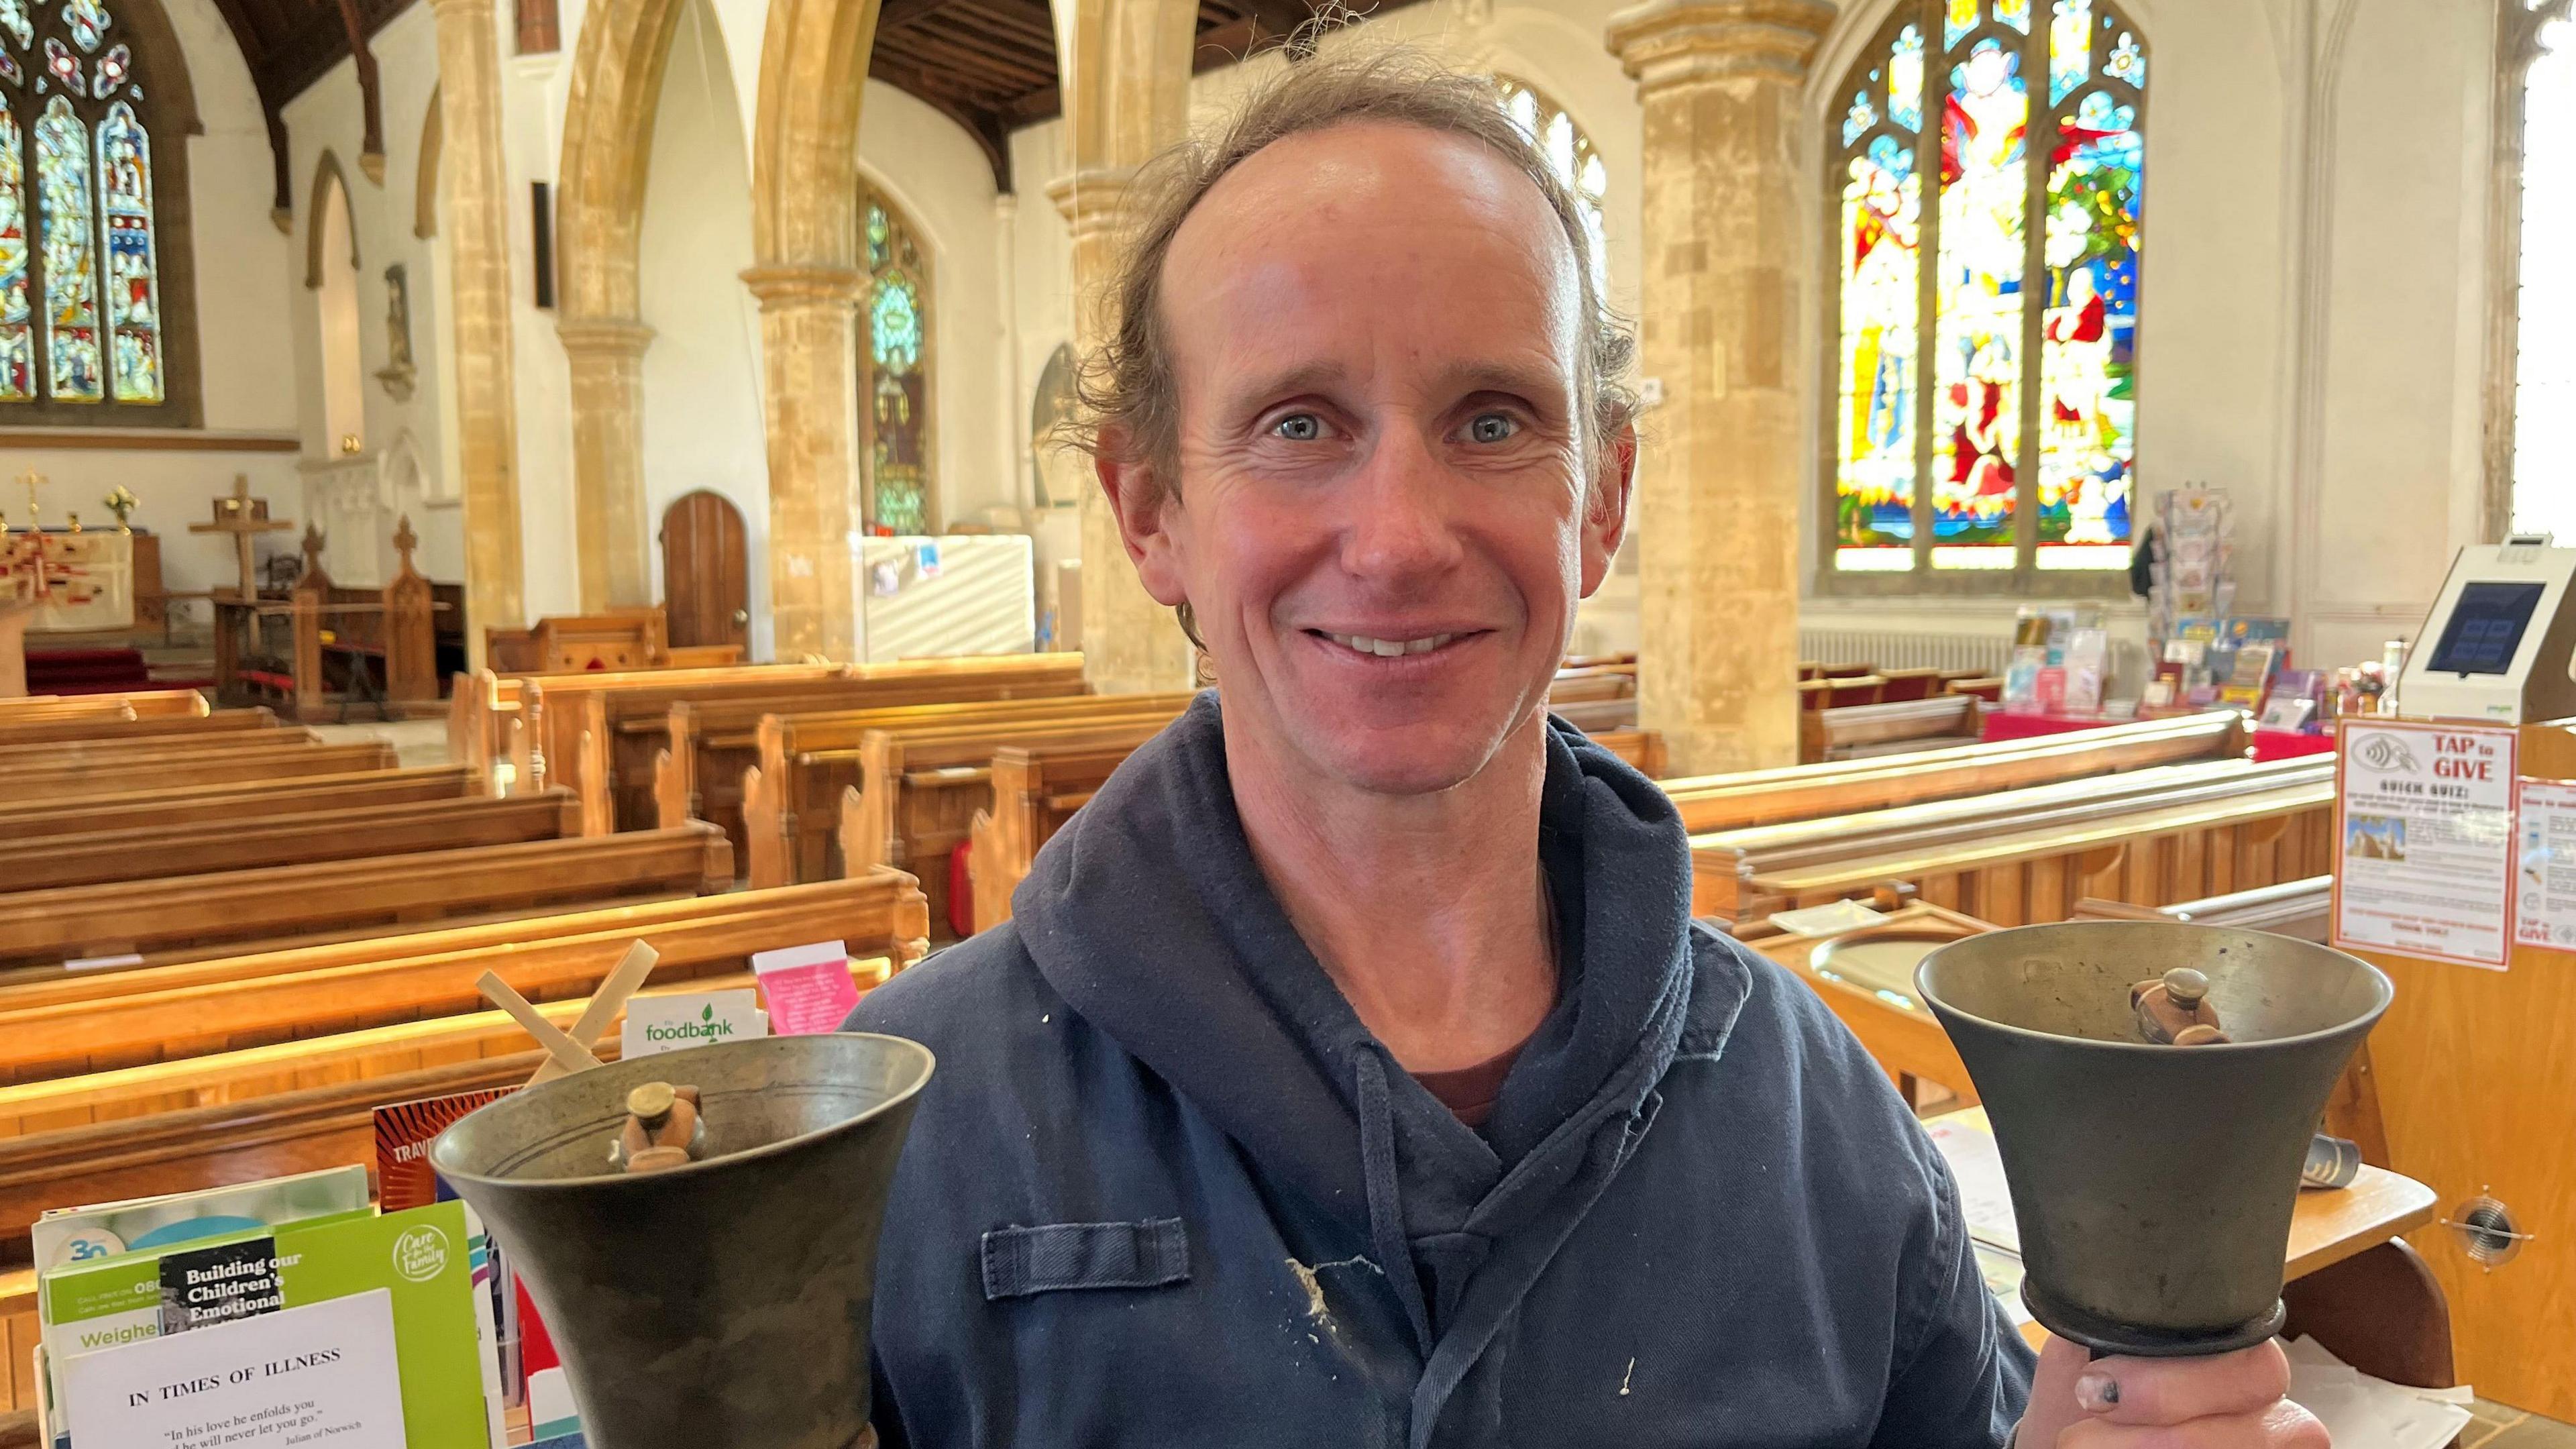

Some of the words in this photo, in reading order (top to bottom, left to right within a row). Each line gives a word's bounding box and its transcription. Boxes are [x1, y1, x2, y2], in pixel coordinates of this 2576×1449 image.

[2432, 734, 2475, 755] TAP
[2479, 743, 2493, 756] to
[2433, 757, 2493, 782] GIVE
[646, 1018, 734, 1041] foodbank
[402, 1232, 435, 1253] Care
[186, 1257, 266, 1285] Building
[268, 1253, 303, 1269] our
[402, 1248, 445, 1274] Family
[187, 1272, 284, 1303] Children's
[190, 1290, 286, 1322] Emotional
[80, 1323, 158, 1348] Weighe
[128, 1390, 150, 1407] IN
[158, 1375, 221, 1400] TIMES
[229, 1366, 256, 1384] OF
[264, 1347, 341, 1377] ILLNESS
[186, 1425, 203, 1438] his
[206, 1419, 231, 1433] love
[233, 1415, 248, 1426] he
[250, 1404, 291, 1422] enfolds
[294, 1400, 315, 1415] you
[199, 1434, 221, 1448] will
[225, 1428, 256, 1443] never
[259, 1424, 273, 1435] let
[276, 1418, 297, 1434] you
[286, 1434, 312, 1446] Julian
[313, 1428, 323, 1439] of
[324, 1420, 362, 1437] Norwich
